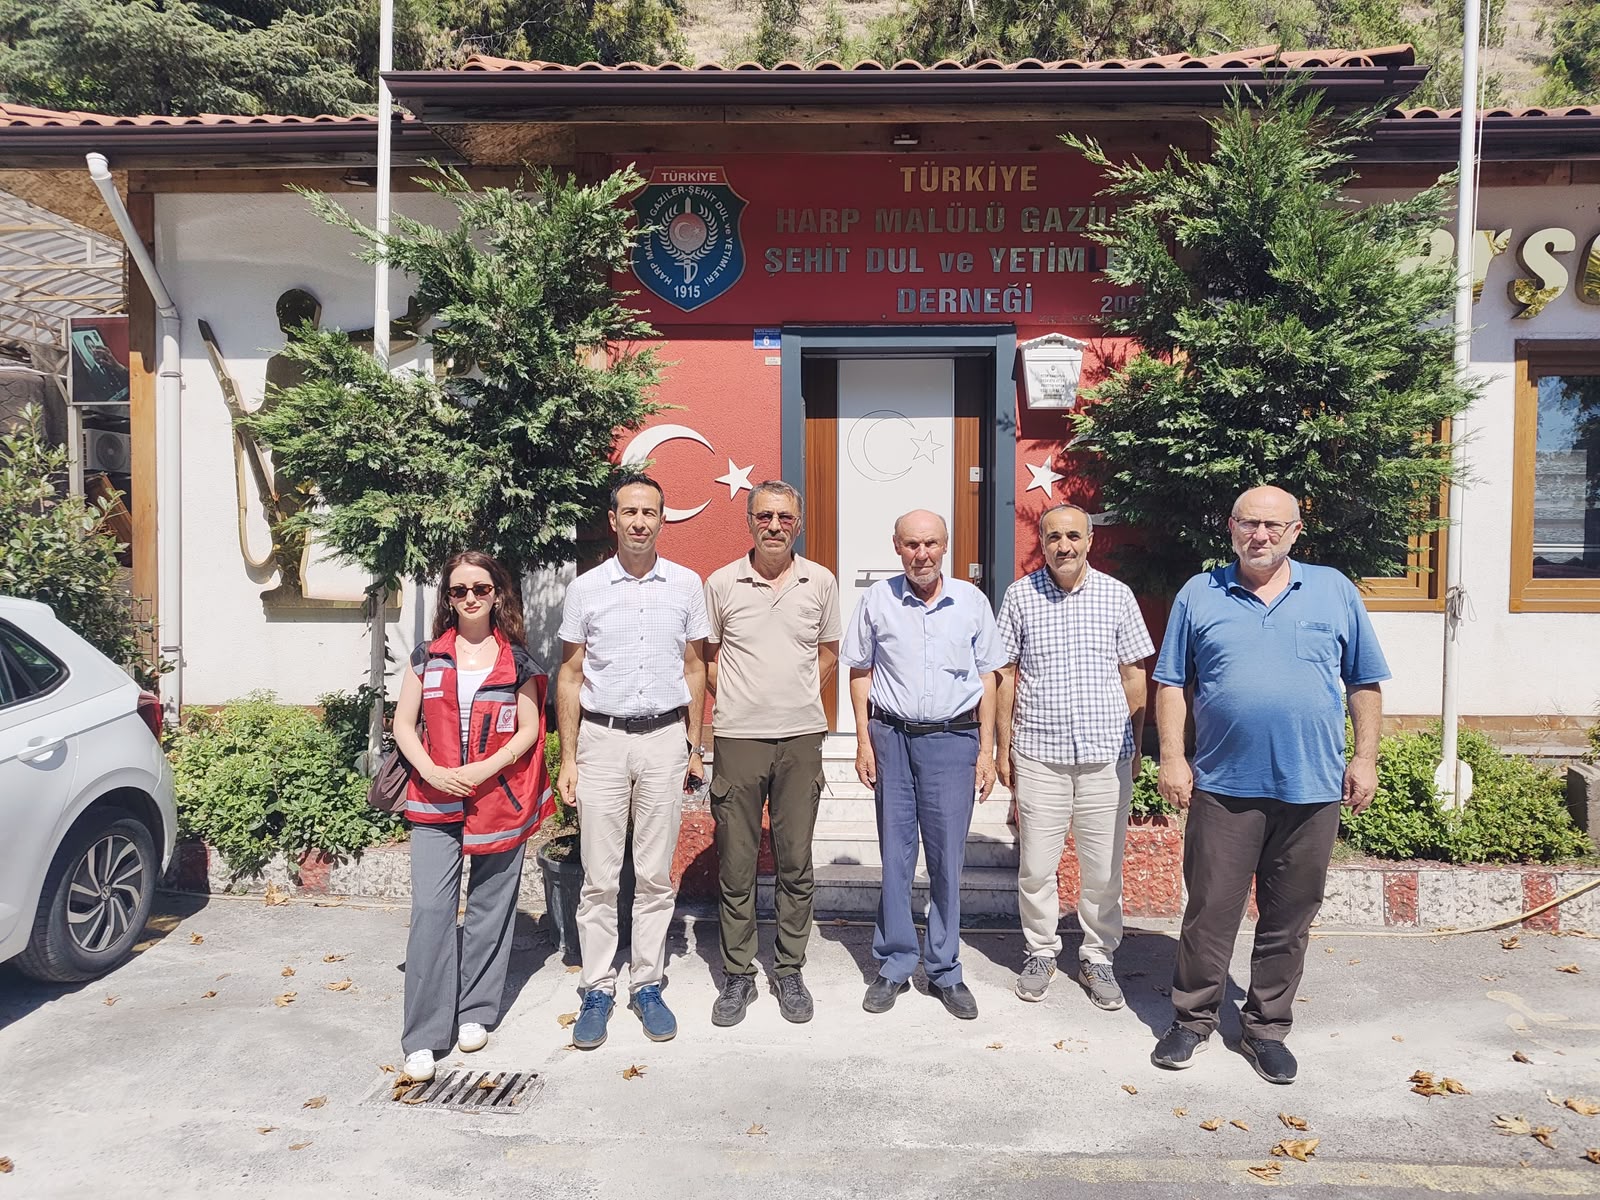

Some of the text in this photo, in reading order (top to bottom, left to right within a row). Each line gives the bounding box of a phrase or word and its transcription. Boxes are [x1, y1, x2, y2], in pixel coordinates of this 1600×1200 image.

[661, 170, 717, 182] TÜRKİYE
[900, 161, 1038, 192] TÜRKİYE
[776, 208, 860, 233] HARP
[875, 202, 1005, 233] MALÜLÜ
[650, 262, 672, 285] HARP
[715, 201, 727, 221] DUL
[724, 223, 732, 235] ve
[764, 242, 850, 278] ŞEHİT
[866, 247, 924, 273] DUL
[939, 252, 974, 273] ve
[674, 285, 700, 298] 1915
[897, 282, 1033, 313] DERNEĞİ
[763, 335, 770, 346] 6
